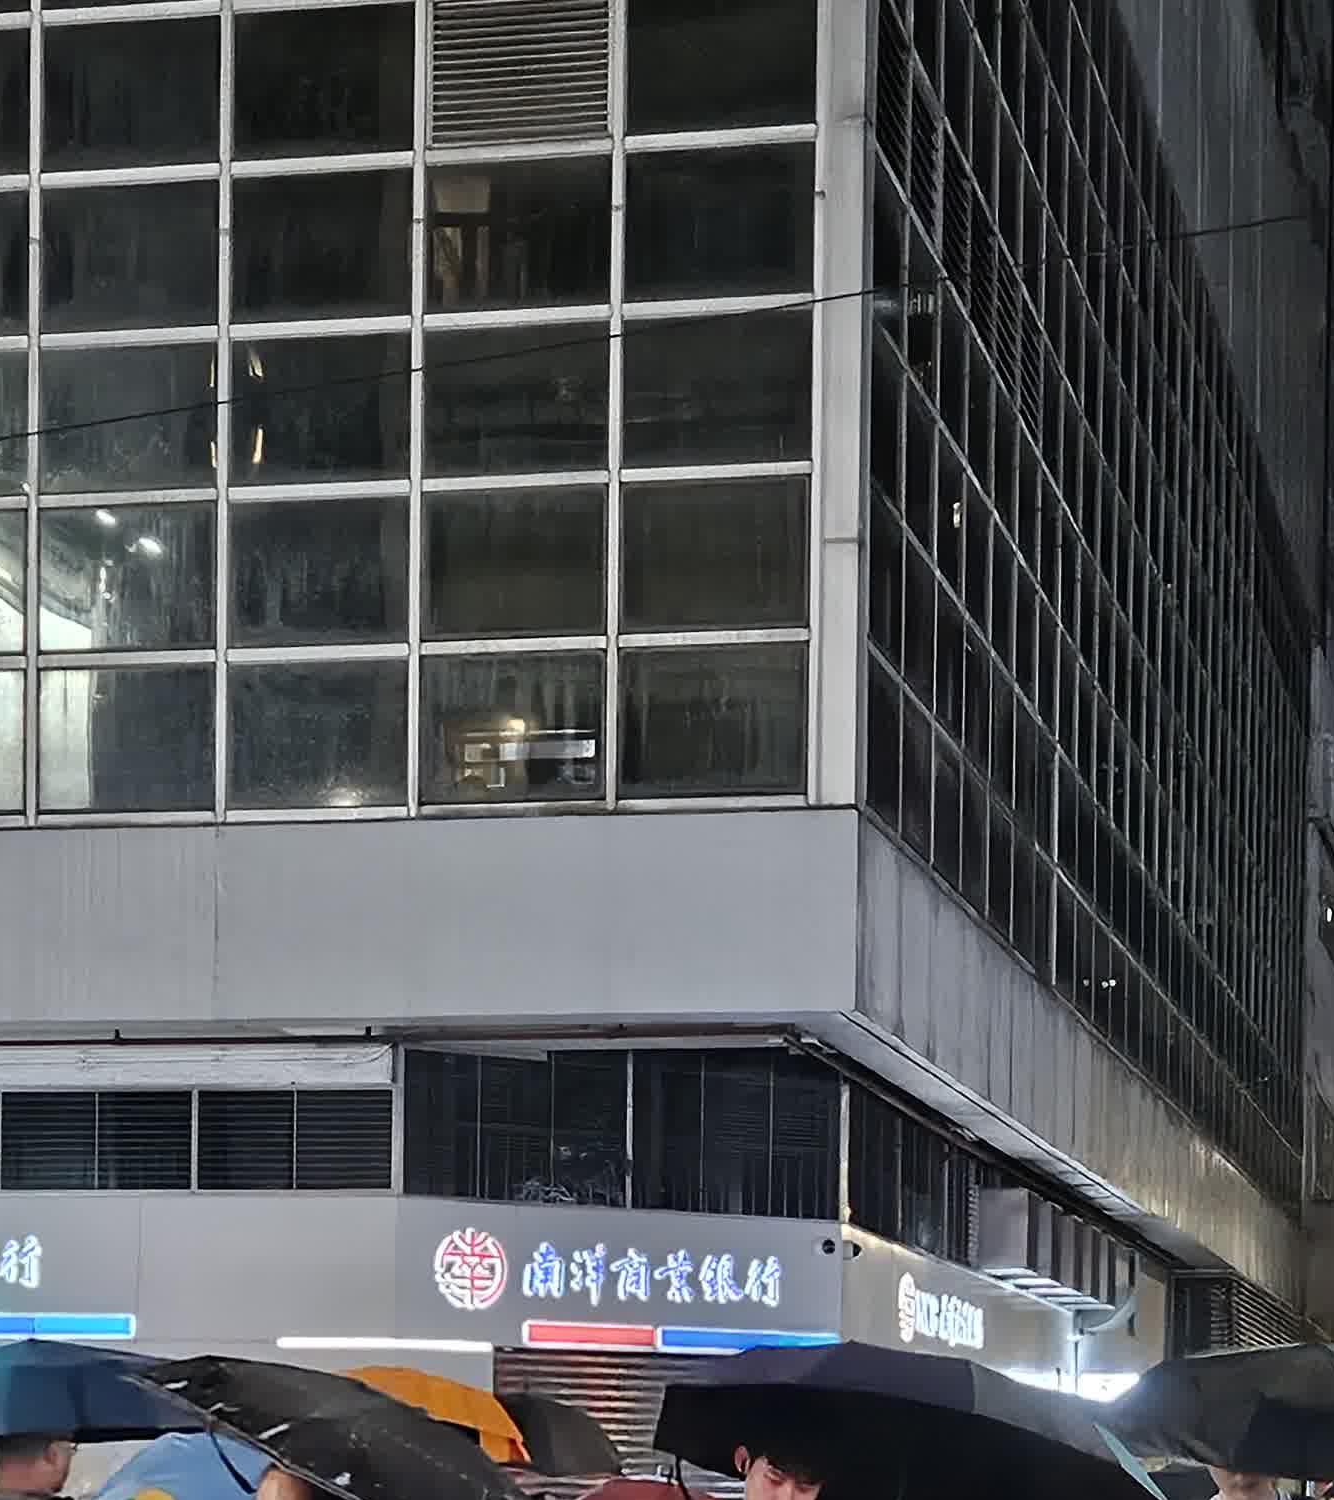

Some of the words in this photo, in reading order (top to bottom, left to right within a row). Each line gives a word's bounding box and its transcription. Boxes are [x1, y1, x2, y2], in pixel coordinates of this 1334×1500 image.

[522, 1240, 783, 1308] 南洋商業銀行
